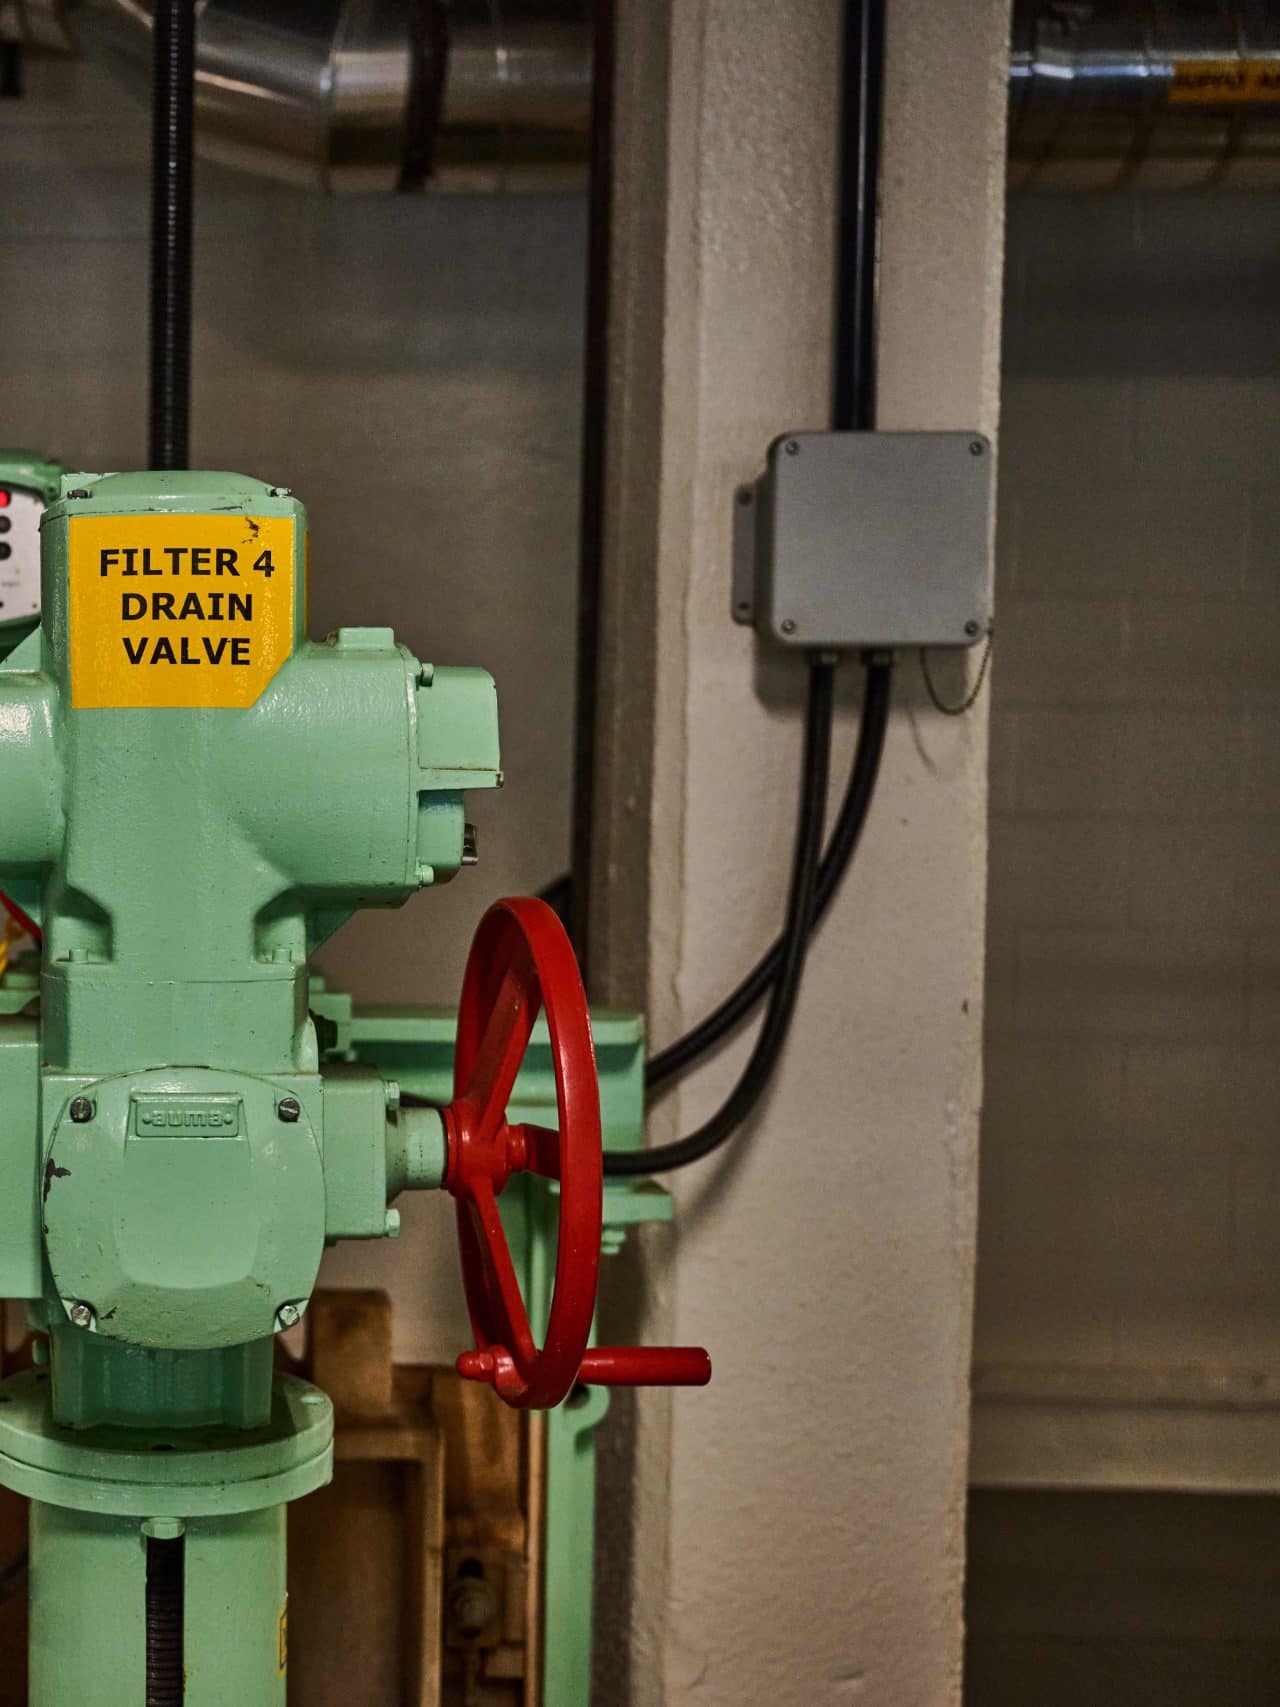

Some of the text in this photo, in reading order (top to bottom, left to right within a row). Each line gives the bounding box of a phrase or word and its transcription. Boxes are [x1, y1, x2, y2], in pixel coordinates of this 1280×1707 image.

[100, 548, 275, 577] FILTER 4
[121, 592, 253, 621] DRAIN
[122, 637, 251, 665] VALVE
